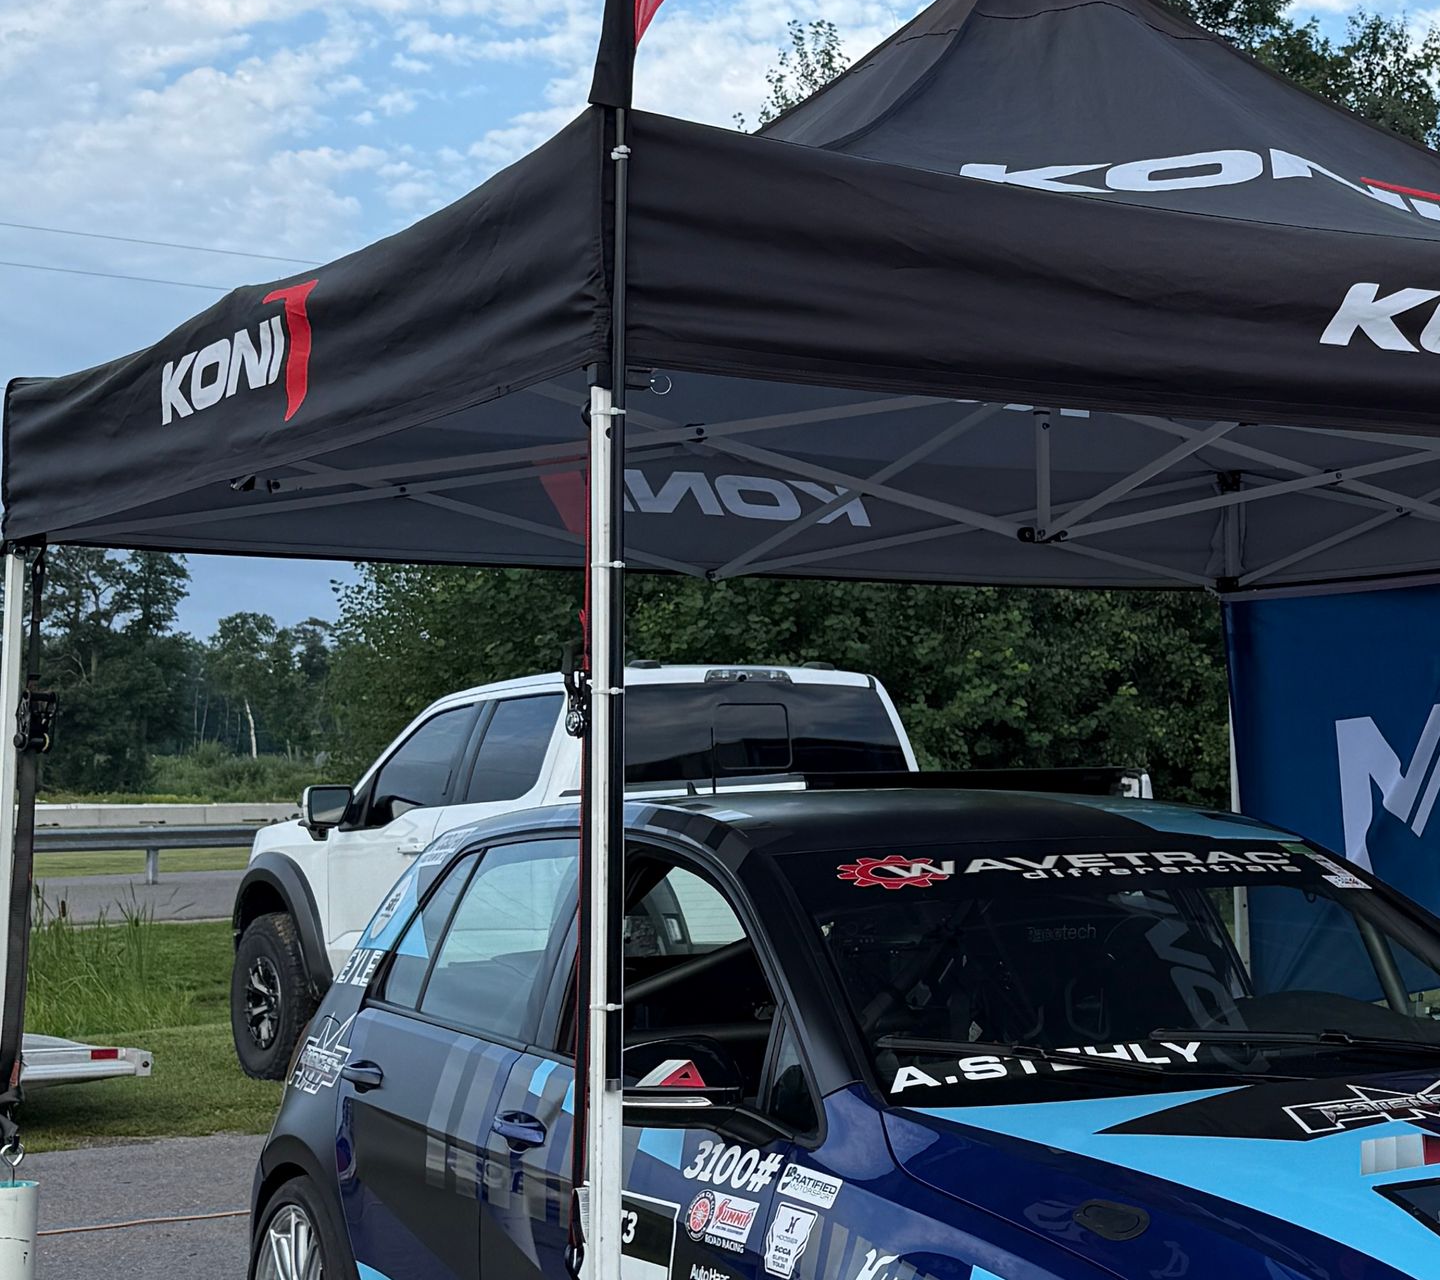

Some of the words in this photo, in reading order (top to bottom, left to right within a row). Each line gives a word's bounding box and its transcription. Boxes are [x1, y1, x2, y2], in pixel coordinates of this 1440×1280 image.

[160, 313, 286, 426] KONI
[882, 851, 1287, 879] WAVETRAC
[1022, 860, 1302, 881] differentials
[683, 1140, 784, 1193] 3100#
[715, 1198, 759, 1231] SUMMIT
